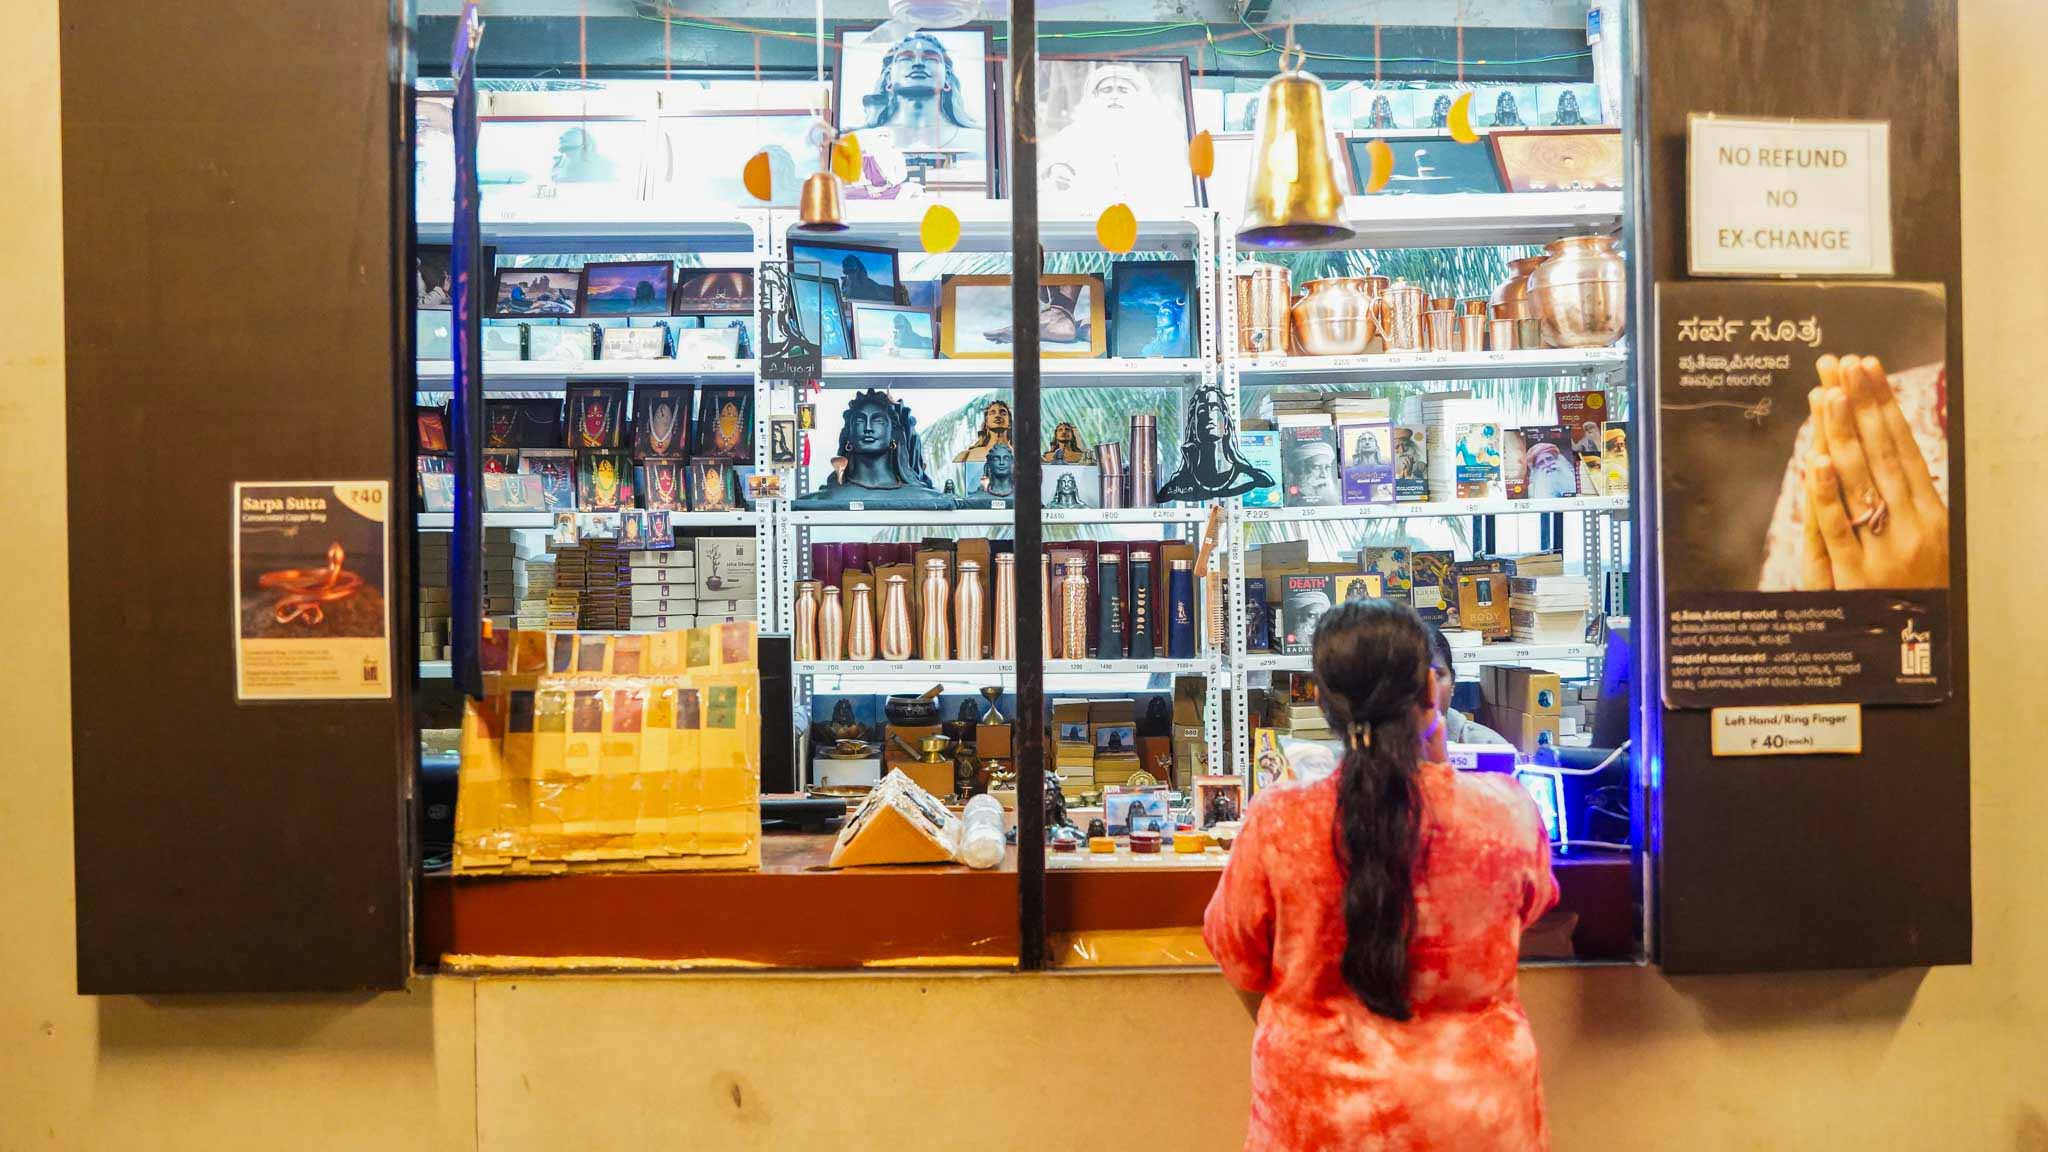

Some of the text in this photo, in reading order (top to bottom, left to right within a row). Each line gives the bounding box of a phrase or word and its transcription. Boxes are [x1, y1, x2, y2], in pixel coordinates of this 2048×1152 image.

[1719, 147, 1848, 168] NO REFUND
[1766, 190, 1798, 208] NO
[1718, 229, 1852, 249] EX-CHANGE
[242, 496, 327, 513] Sarpa Sutra
[1289, 577, 1326, 589] DEATH
[1725, 713, 1847, 727] Left Hand/Ring Finger
